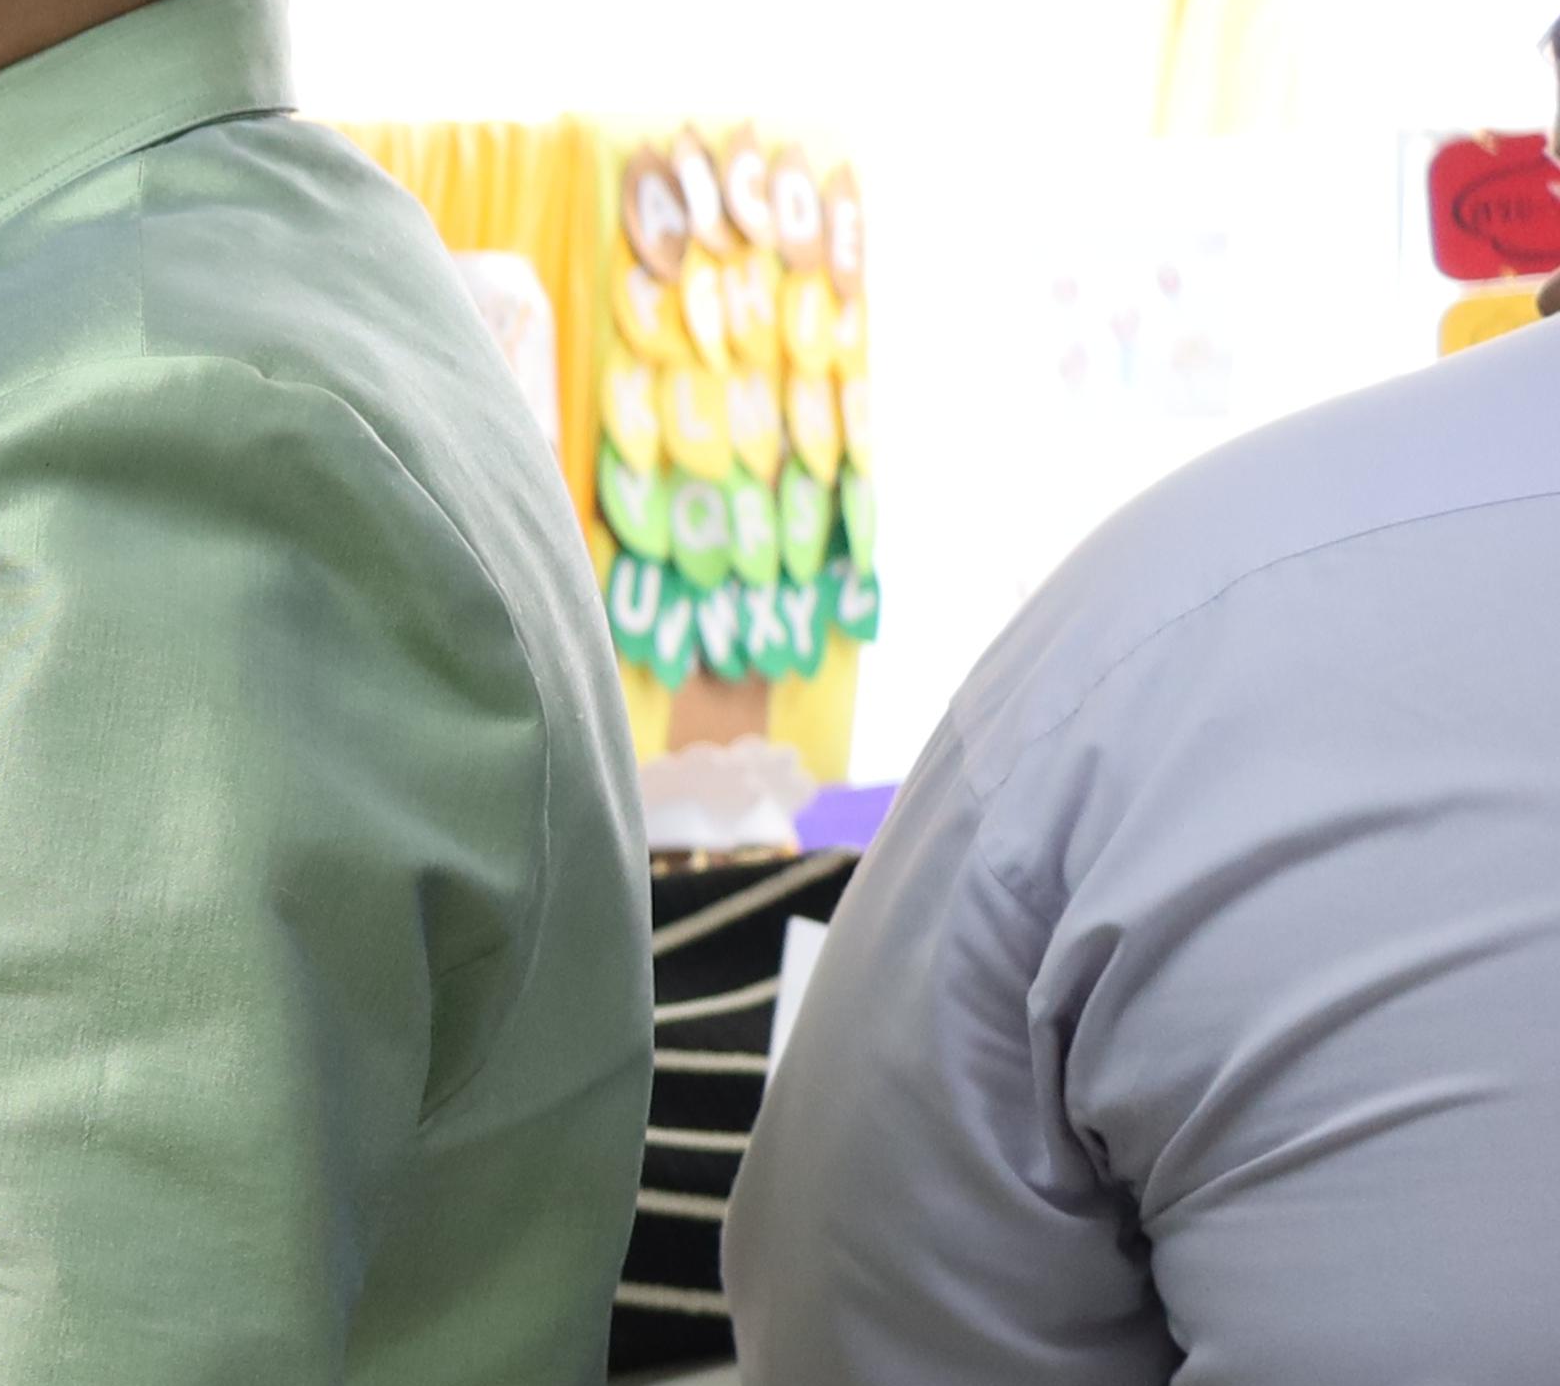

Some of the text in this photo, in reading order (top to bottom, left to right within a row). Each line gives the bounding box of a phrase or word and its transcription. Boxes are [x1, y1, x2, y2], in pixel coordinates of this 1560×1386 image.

[637, 173, 686, 250] A
[726, 151, 770, 229] C
[774, 169, 820, 243] D
[611, 369, 658, 442] K
[673, 374, 716, 444] L
[611, 560, 661, 634] U
[741, 583, 786, 656] X
[780, 583, 817, 656] Y
